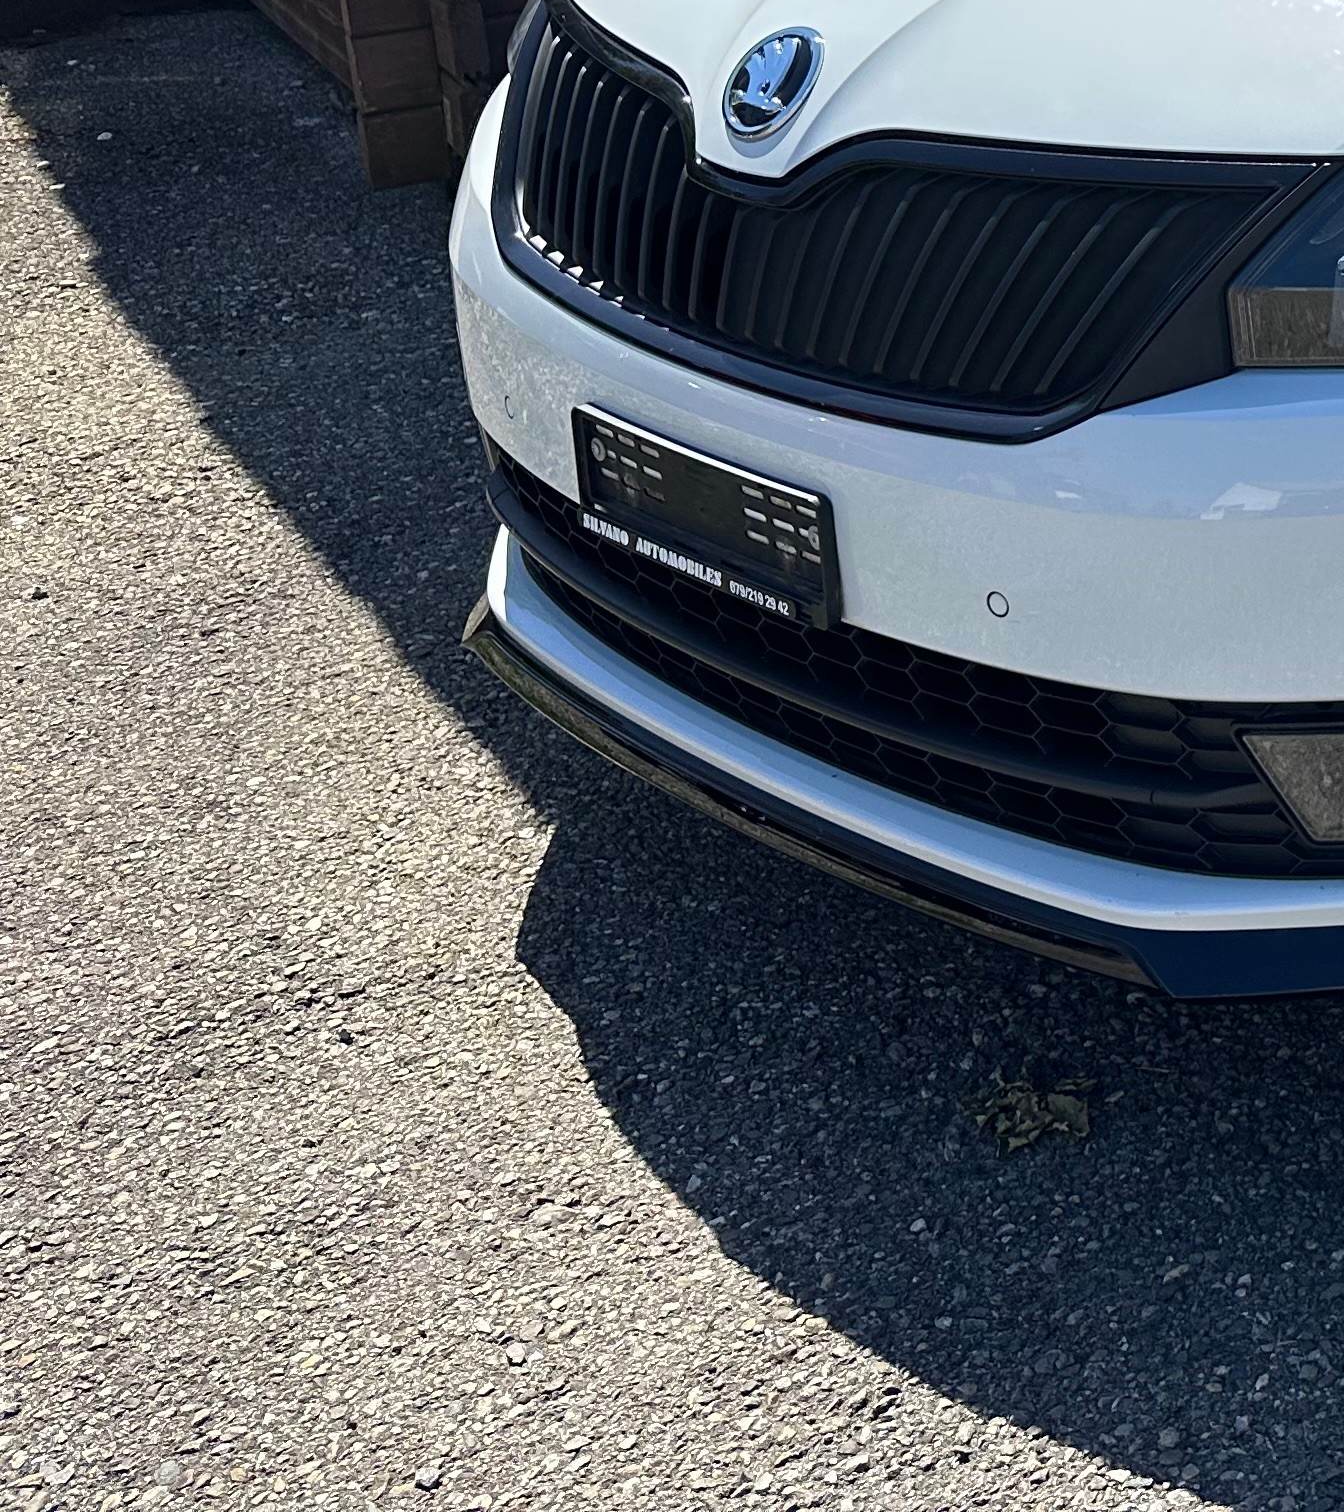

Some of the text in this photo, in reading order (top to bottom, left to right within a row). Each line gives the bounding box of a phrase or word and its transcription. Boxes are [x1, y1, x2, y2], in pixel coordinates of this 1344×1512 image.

[583, 512, 629, 546] SILVANO
[635, 536, 722, 587] AUTOMOBILES
[764, 594, 777, 611] 29
[777, 600, 790, 617] 42
